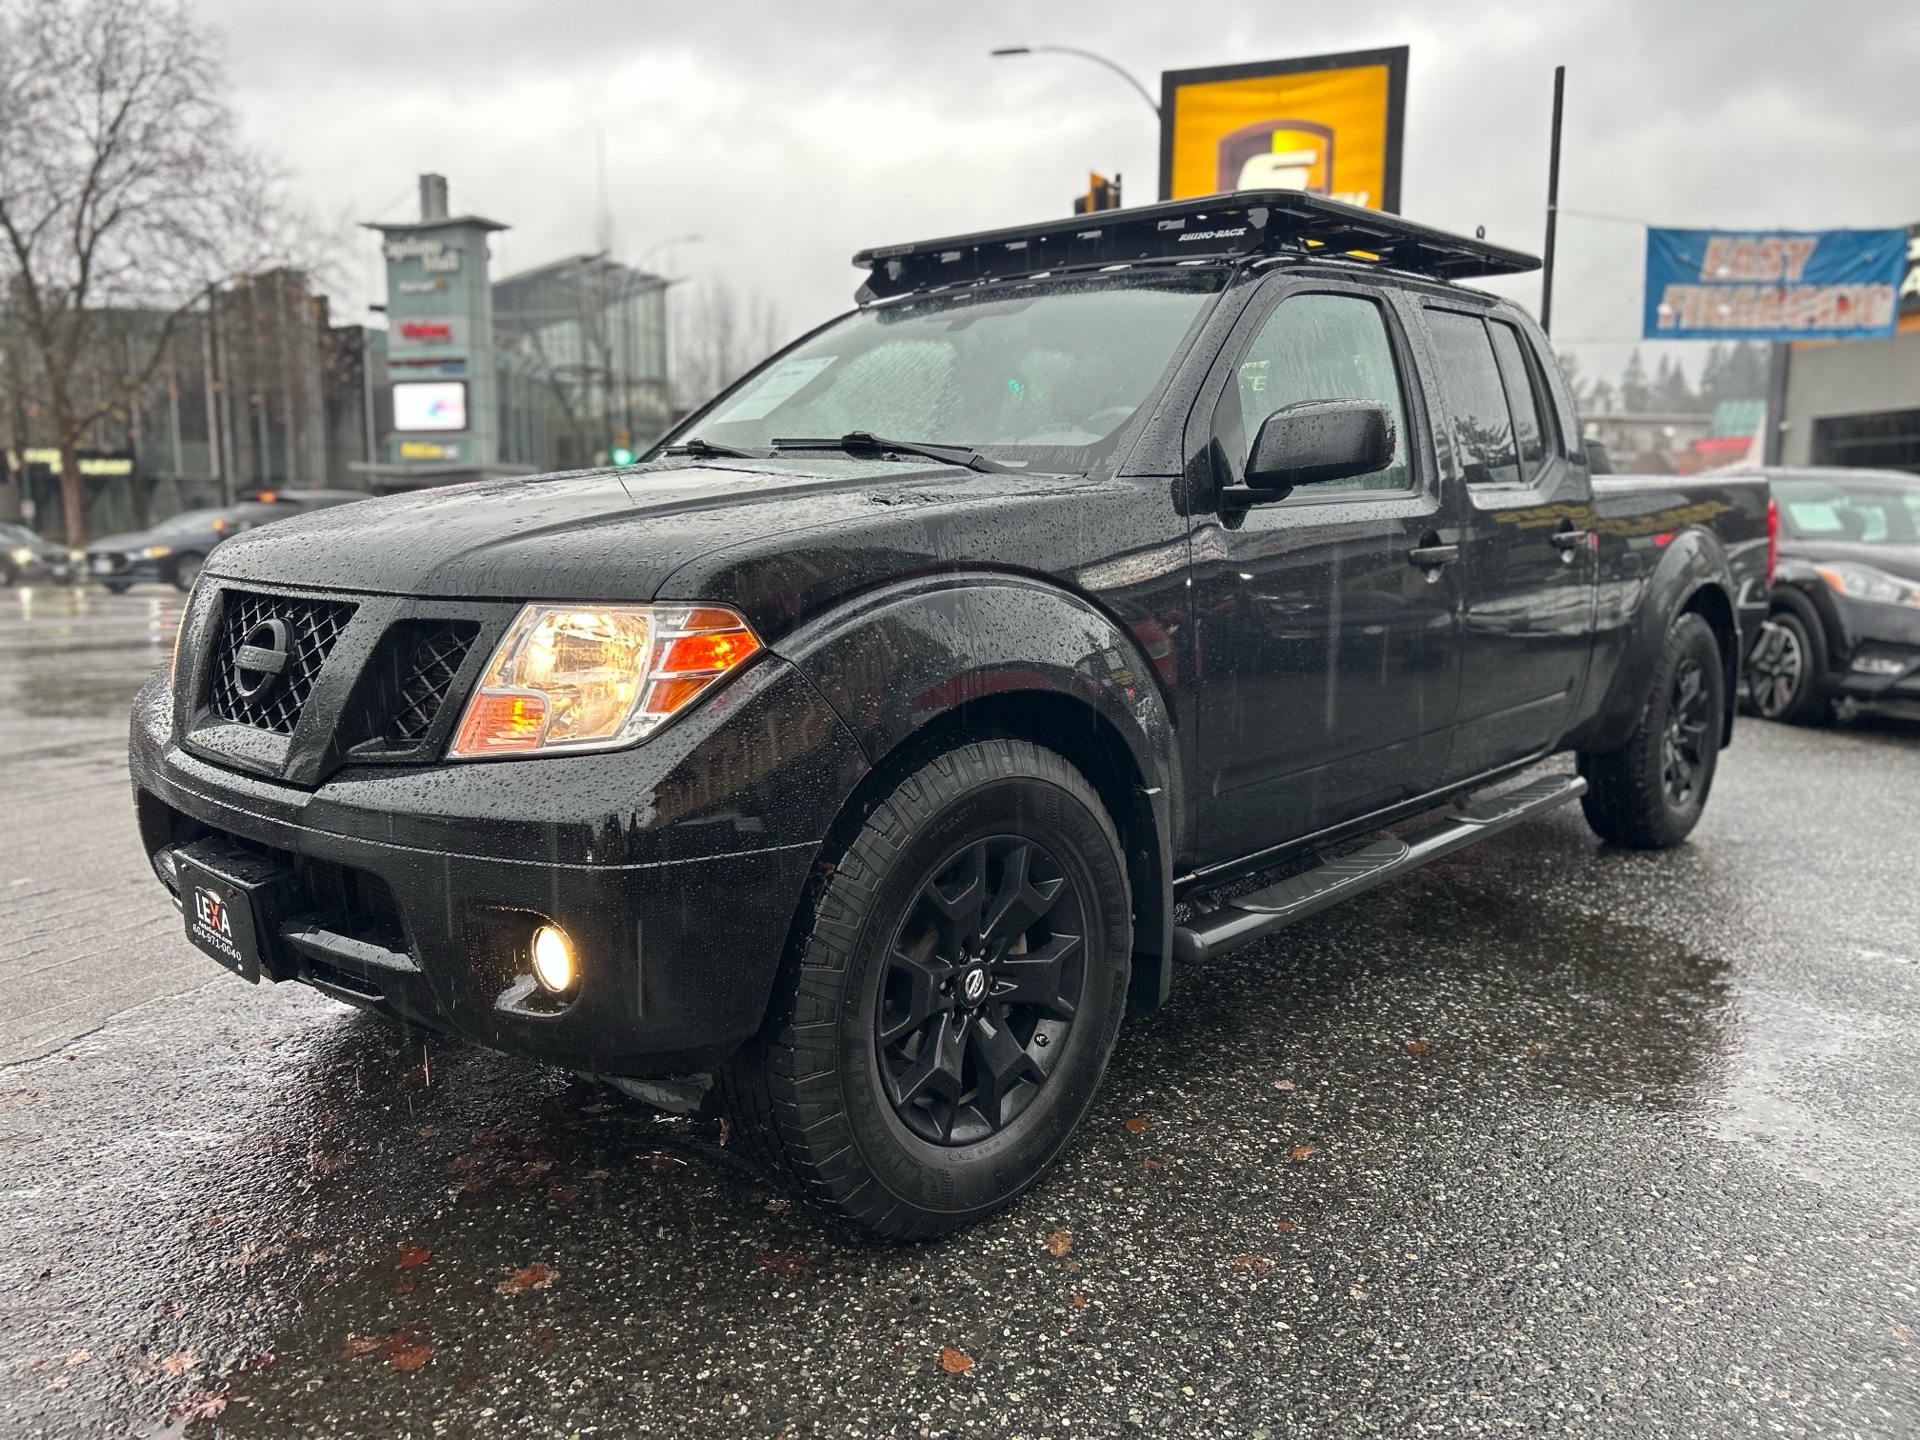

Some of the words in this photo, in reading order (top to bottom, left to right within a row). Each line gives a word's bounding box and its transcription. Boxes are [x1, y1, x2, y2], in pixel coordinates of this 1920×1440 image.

[1178, 227, 1247, 242] RHINO-RACK
[1699, 234, 1819, 282] EASY
[194, 890, 232, 938] LEXA
[192, 923, 242, 961] 604-971-0040
